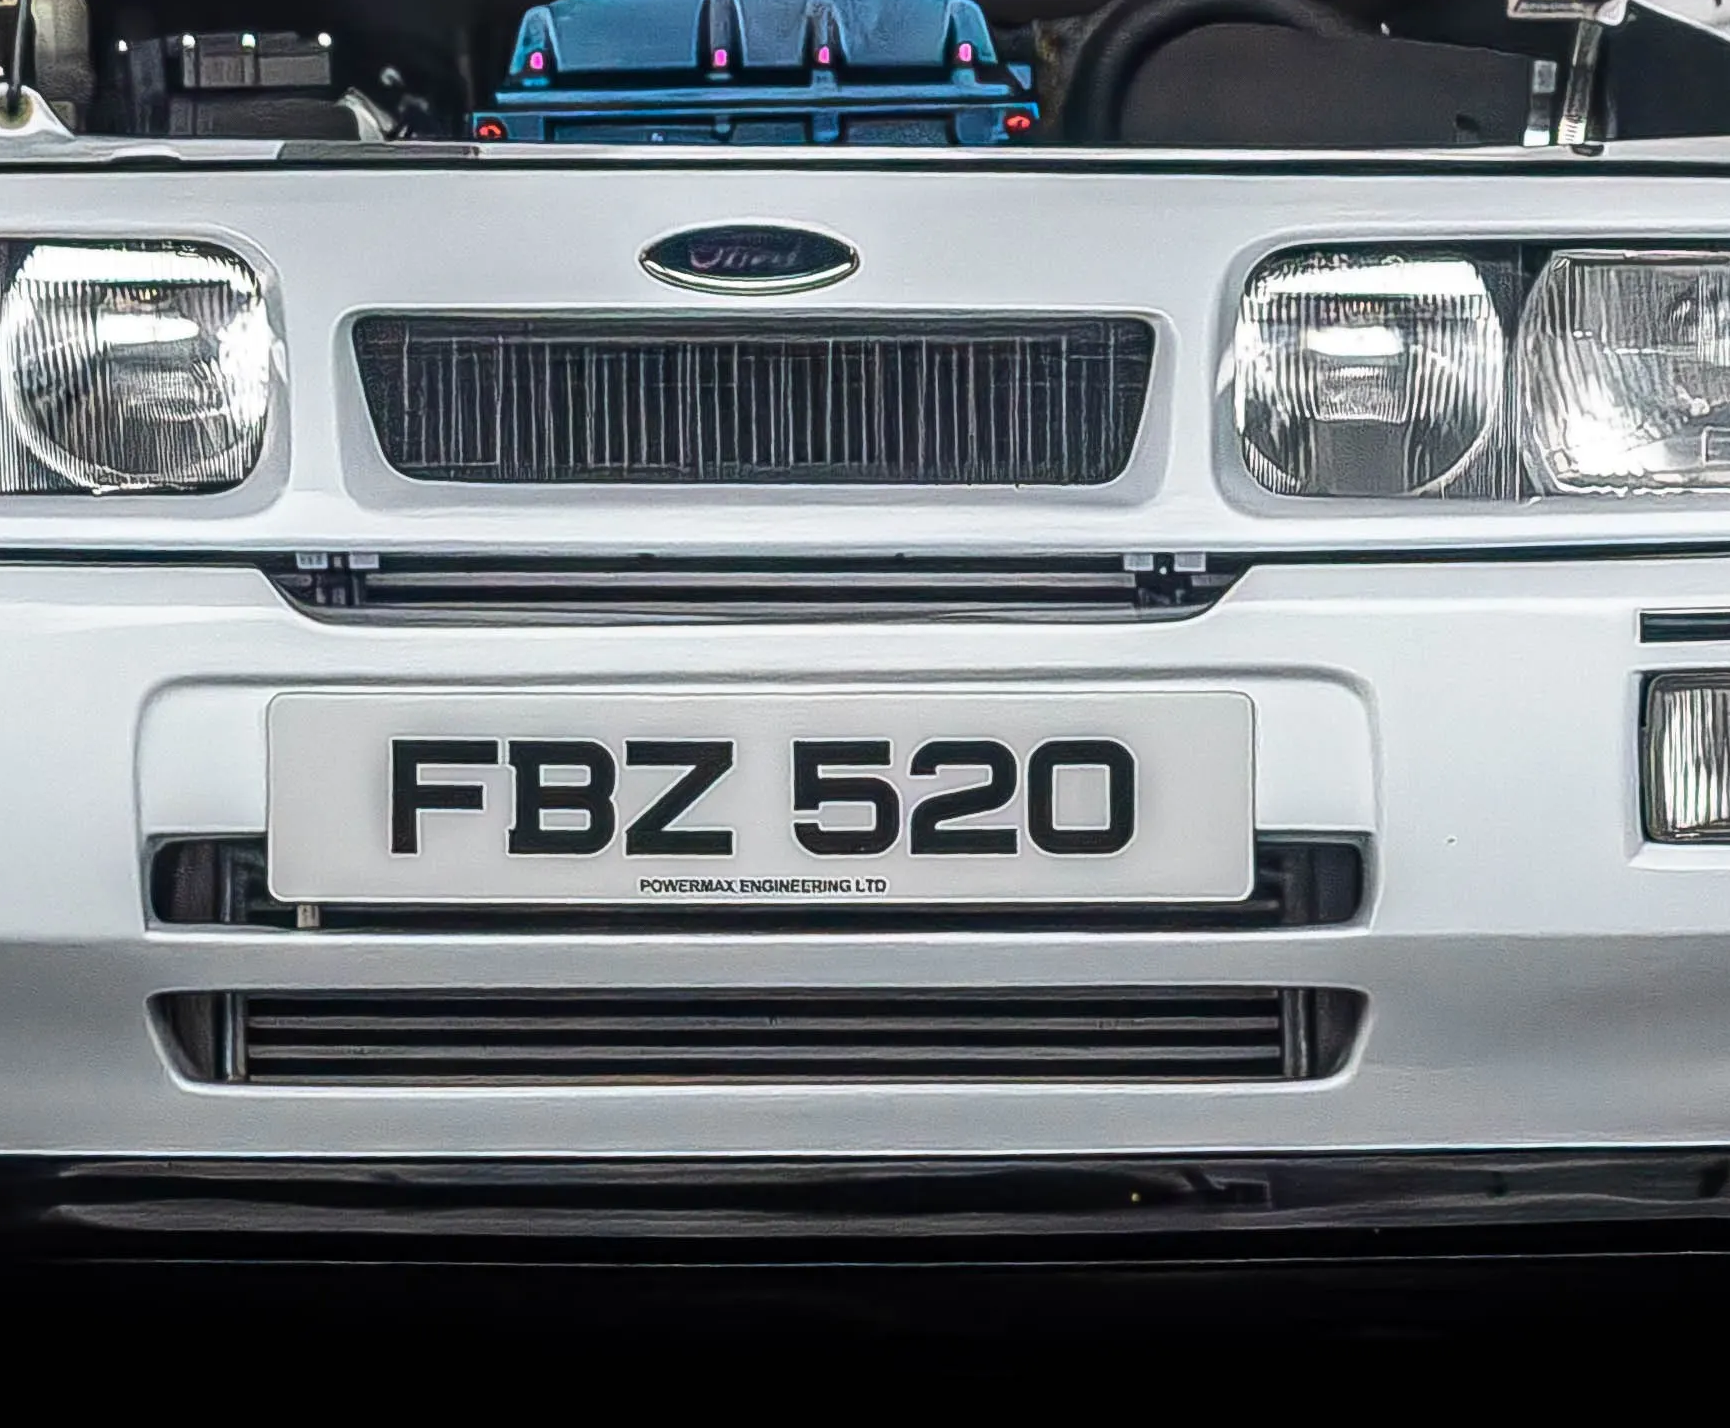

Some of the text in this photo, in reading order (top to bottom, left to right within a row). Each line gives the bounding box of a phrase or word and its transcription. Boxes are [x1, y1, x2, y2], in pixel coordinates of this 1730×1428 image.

[391, 739, 1135, 856] FBZ 520
[640, 878, 887, 894] POWERMAX ENGINEERING LTD
